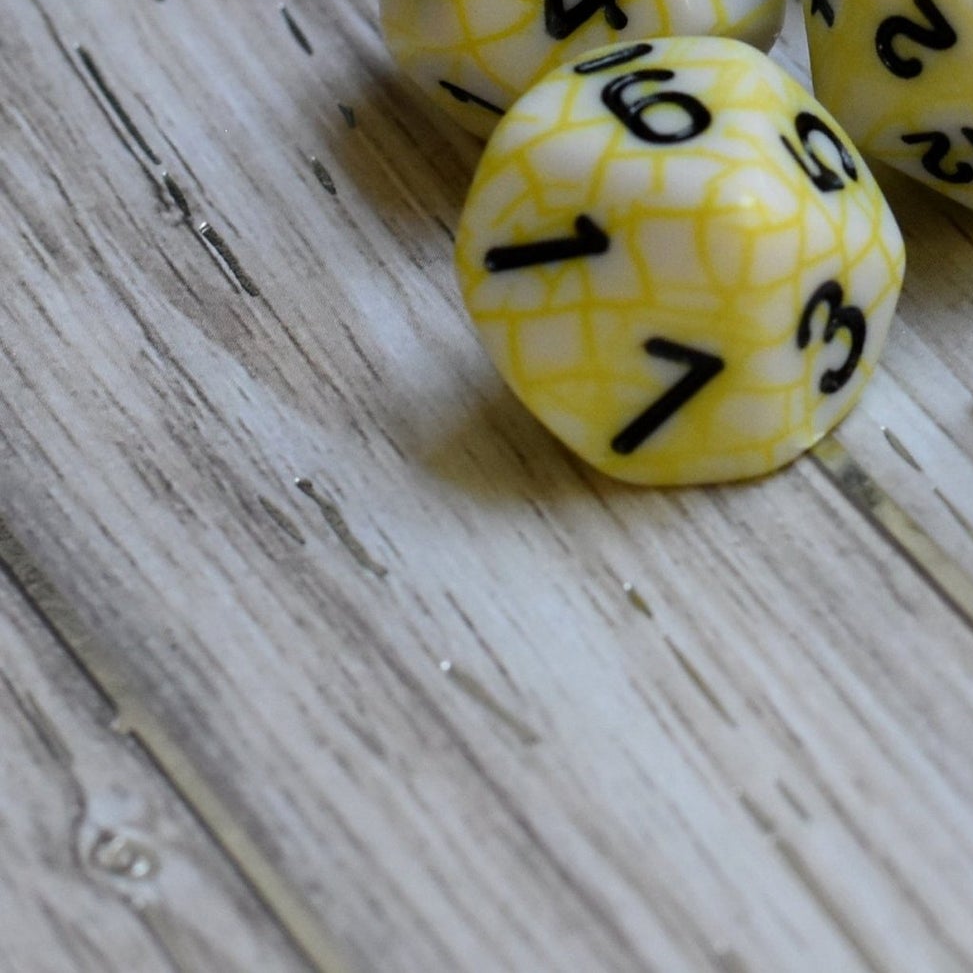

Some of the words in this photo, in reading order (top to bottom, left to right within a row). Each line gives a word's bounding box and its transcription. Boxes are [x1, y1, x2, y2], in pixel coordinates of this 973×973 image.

[781, 111, 858, 192] 5
[484, 213, 610, 273] 1
[798, 279, 867, 395] 3
[611, 336, 724, 455] 7
